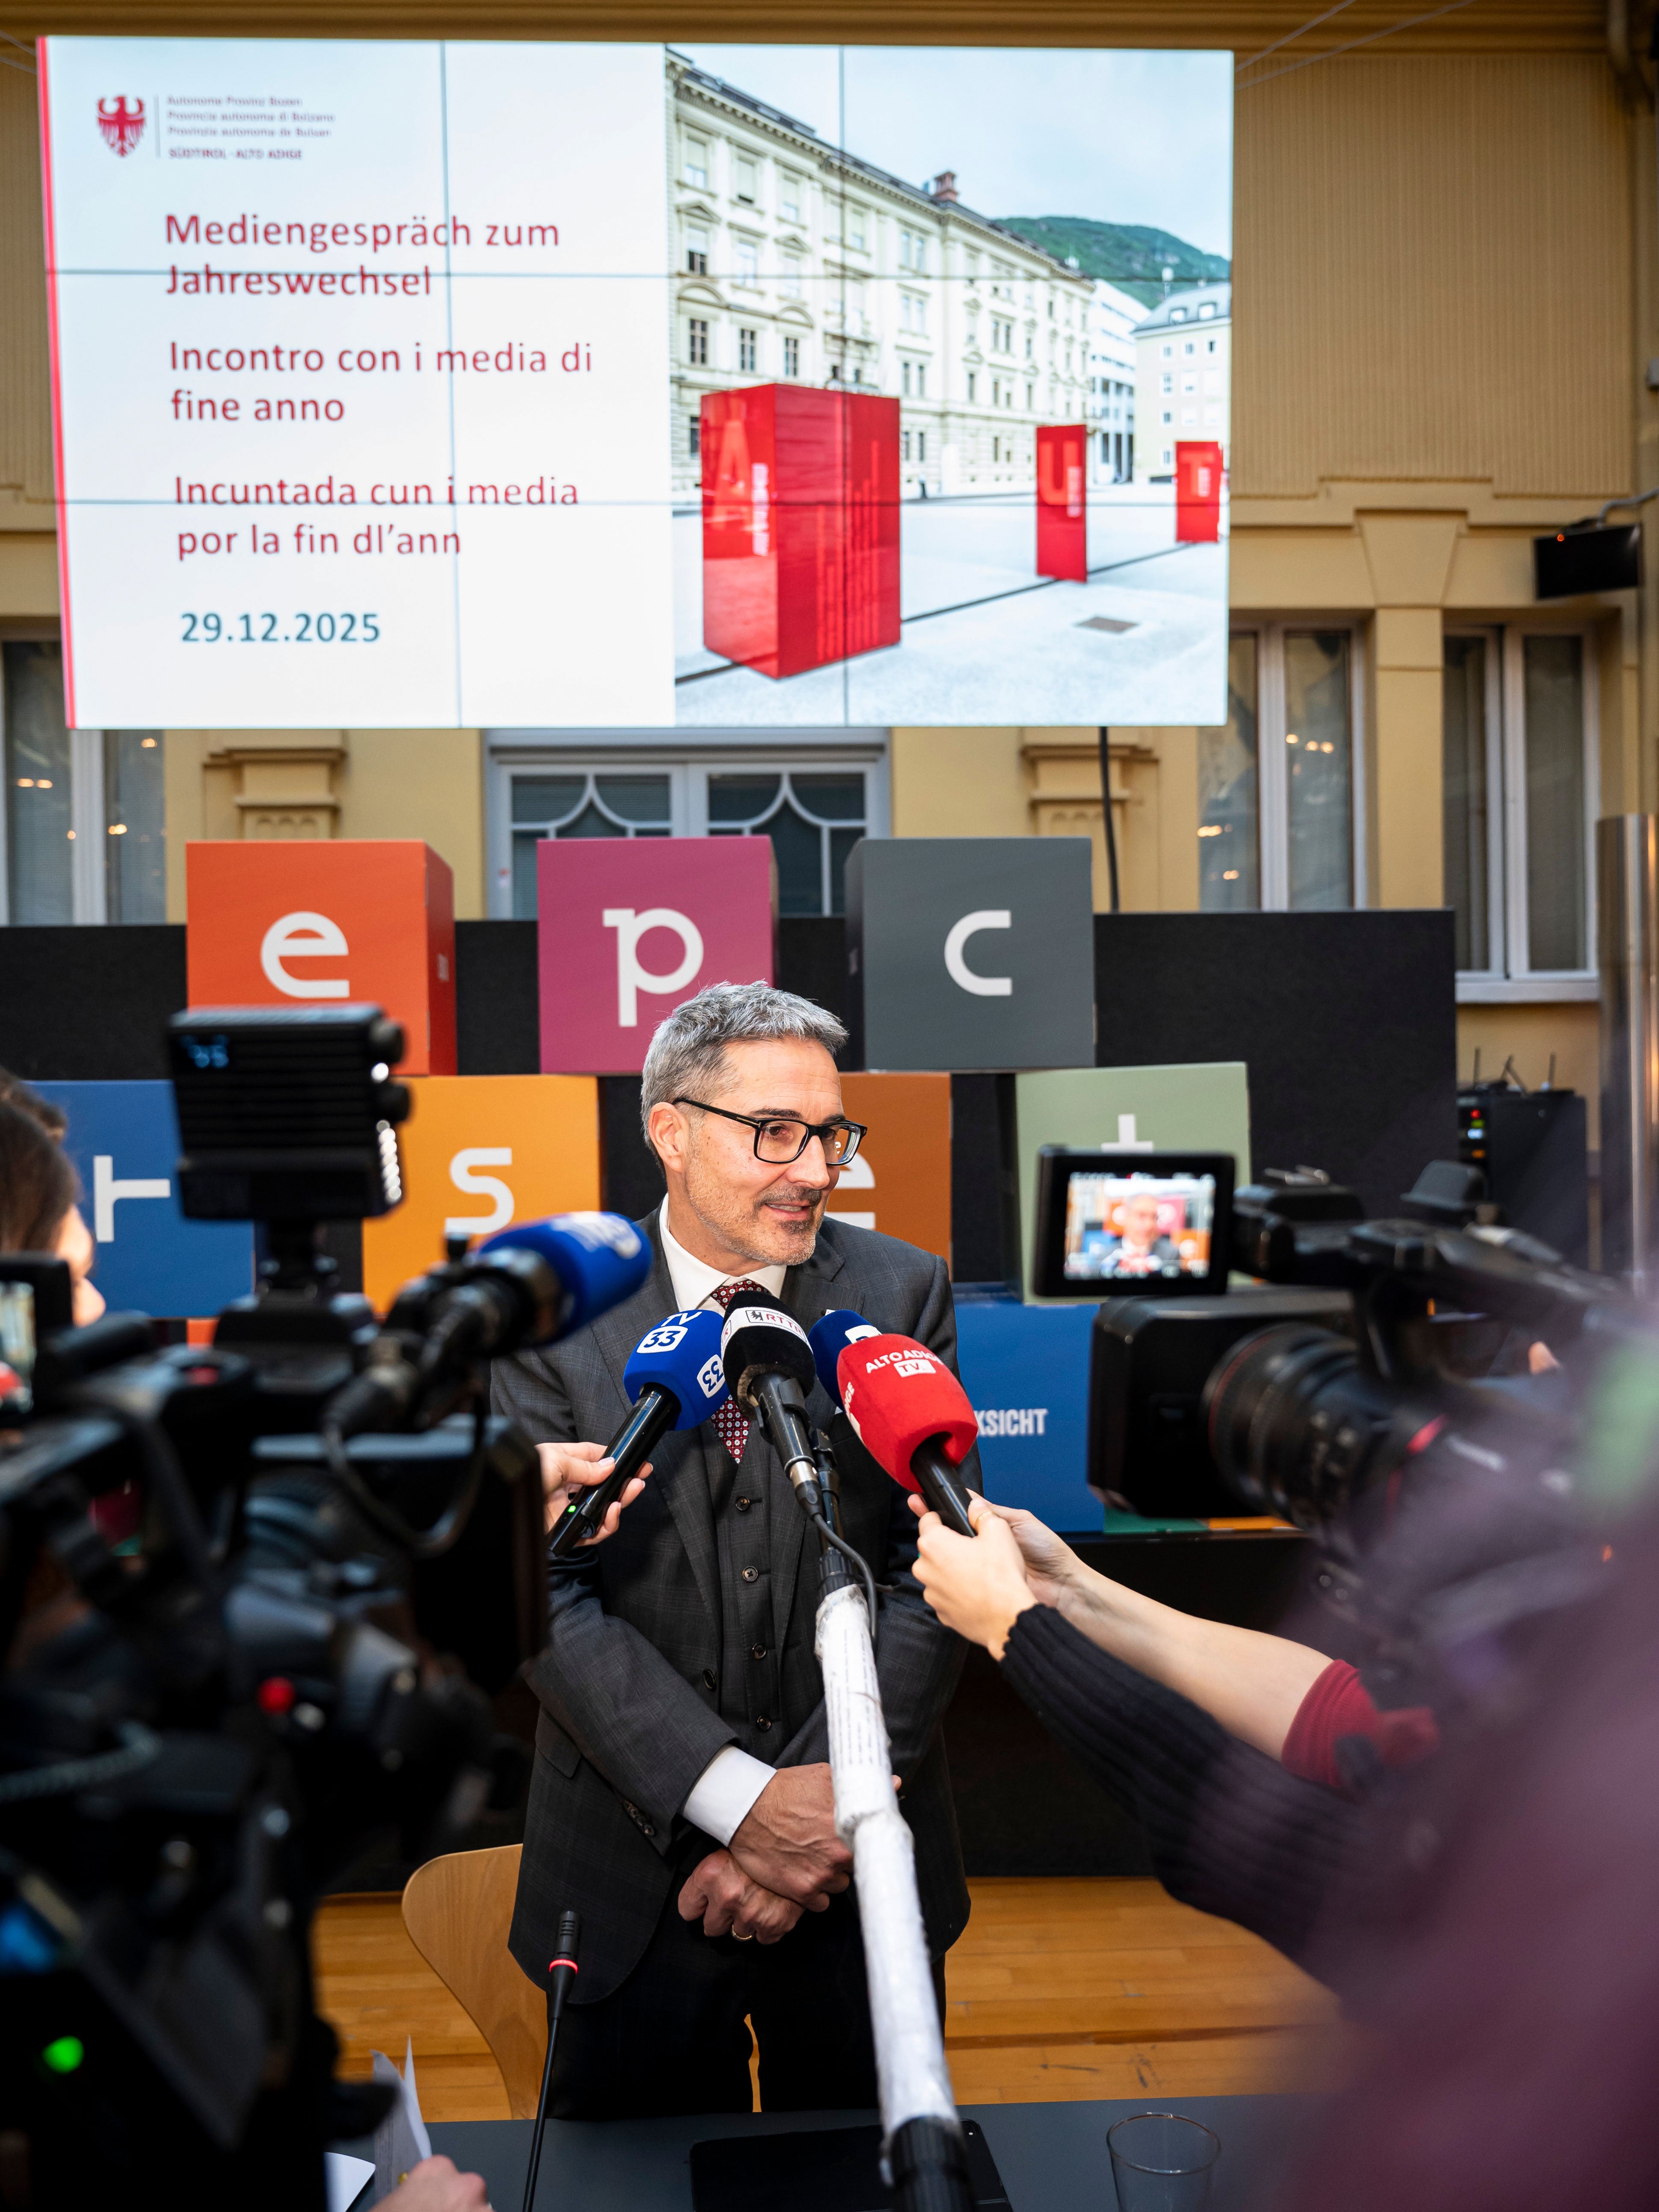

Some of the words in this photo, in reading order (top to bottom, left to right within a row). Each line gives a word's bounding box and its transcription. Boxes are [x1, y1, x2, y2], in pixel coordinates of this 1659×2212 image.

[166, 214, 471, 253] Mediengespräch
[486, 225, 559, 246] zum
[167, 263, 430, 296] Jahreswechsel
[171, 342, 324, 371] Incontro
[337, 350, 400, 372] con
[414, 342, 422, 371] i
[436, 342, 546, 372] media
[561, 342, 591, 373] di
[172, 389, 240, 421] fine
[254, 399, 344, 421] anno
[1038, 441, 1080, 506] U
[1179, 450, 1215, 496] T
[175, 475, 356, 504] Incuntada
[370, 484, 432, 504] cun
[447, 476, 455, 504] i
[468, 476, 578, 505] media
[178, 532, 237, 561] por
[251, 524, 279, 554] la
[293, 523, 338, 553] fin
[181, 612, 380, 643] 29.12.2025
[260, 911, 350, 999] e
[602, 908, 705, 1027] p
[660, 1311, 703, 1327] TV
[766, 1313, 803, 1337] RTTR
[643, 1331, 681, 1348] 33
[702, 1360, 724, 1393] 33
[973, 1408, 1049, 1437] KSICHT
